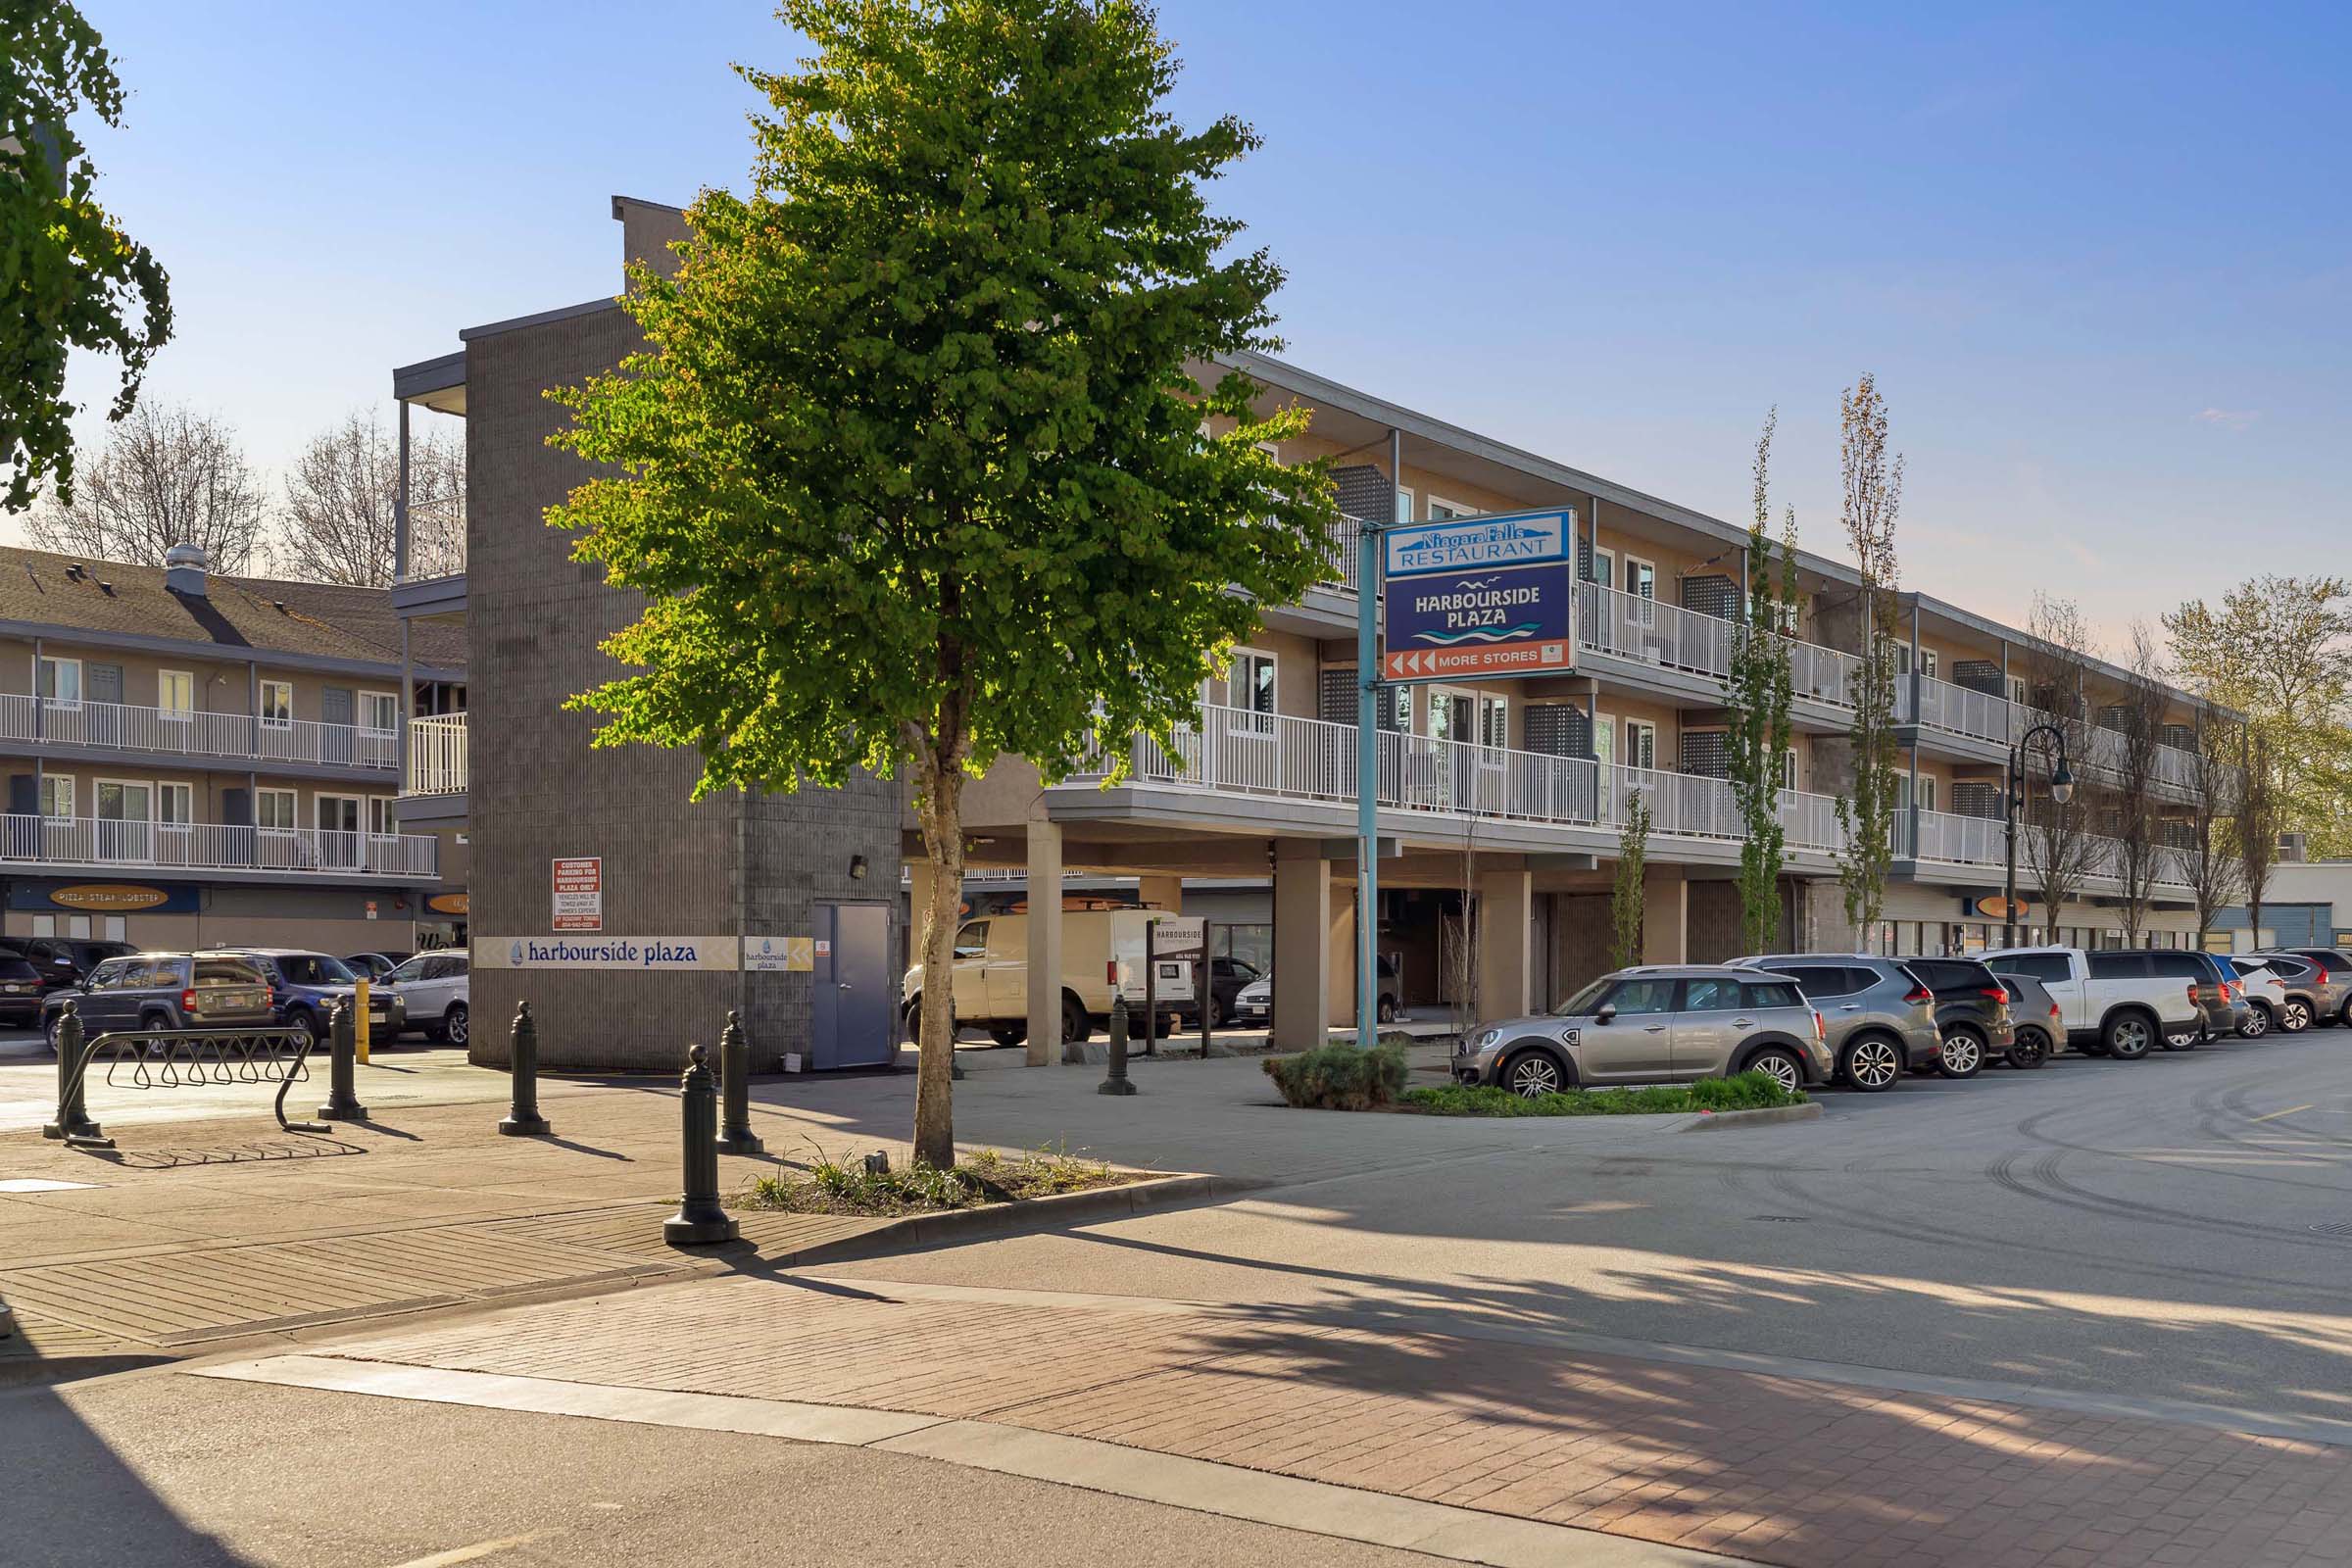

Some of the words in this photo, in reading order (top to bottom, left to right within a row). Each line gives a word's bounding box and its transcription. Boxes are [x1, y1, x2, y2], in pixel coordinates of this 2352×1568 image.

[1422, 532, 1486, 549] Niagara
[1486, 523, 1525, 542] Falls
[1401, 539, 1546, 567] RESTAURANT
[1415, 587, 1540, 612] HARBOURSIDE
[1447, 609, 1506, 628] PLAZA
[1439, 655, 1479, 667] MORE
[1483, 651, 1538, 664] STORES
[59, 893, 84, 902] PIZZA
[122, 893, 159, 902] LOBSTER
[1156, 930, 1201, 939] HARBOURSIDE
[528, 941, 637, 961] harbourside
[644, 941, 698, 965] plaza
[746, 952, 788, 960] harbourside
[758, 961, 777, 970] plaza
